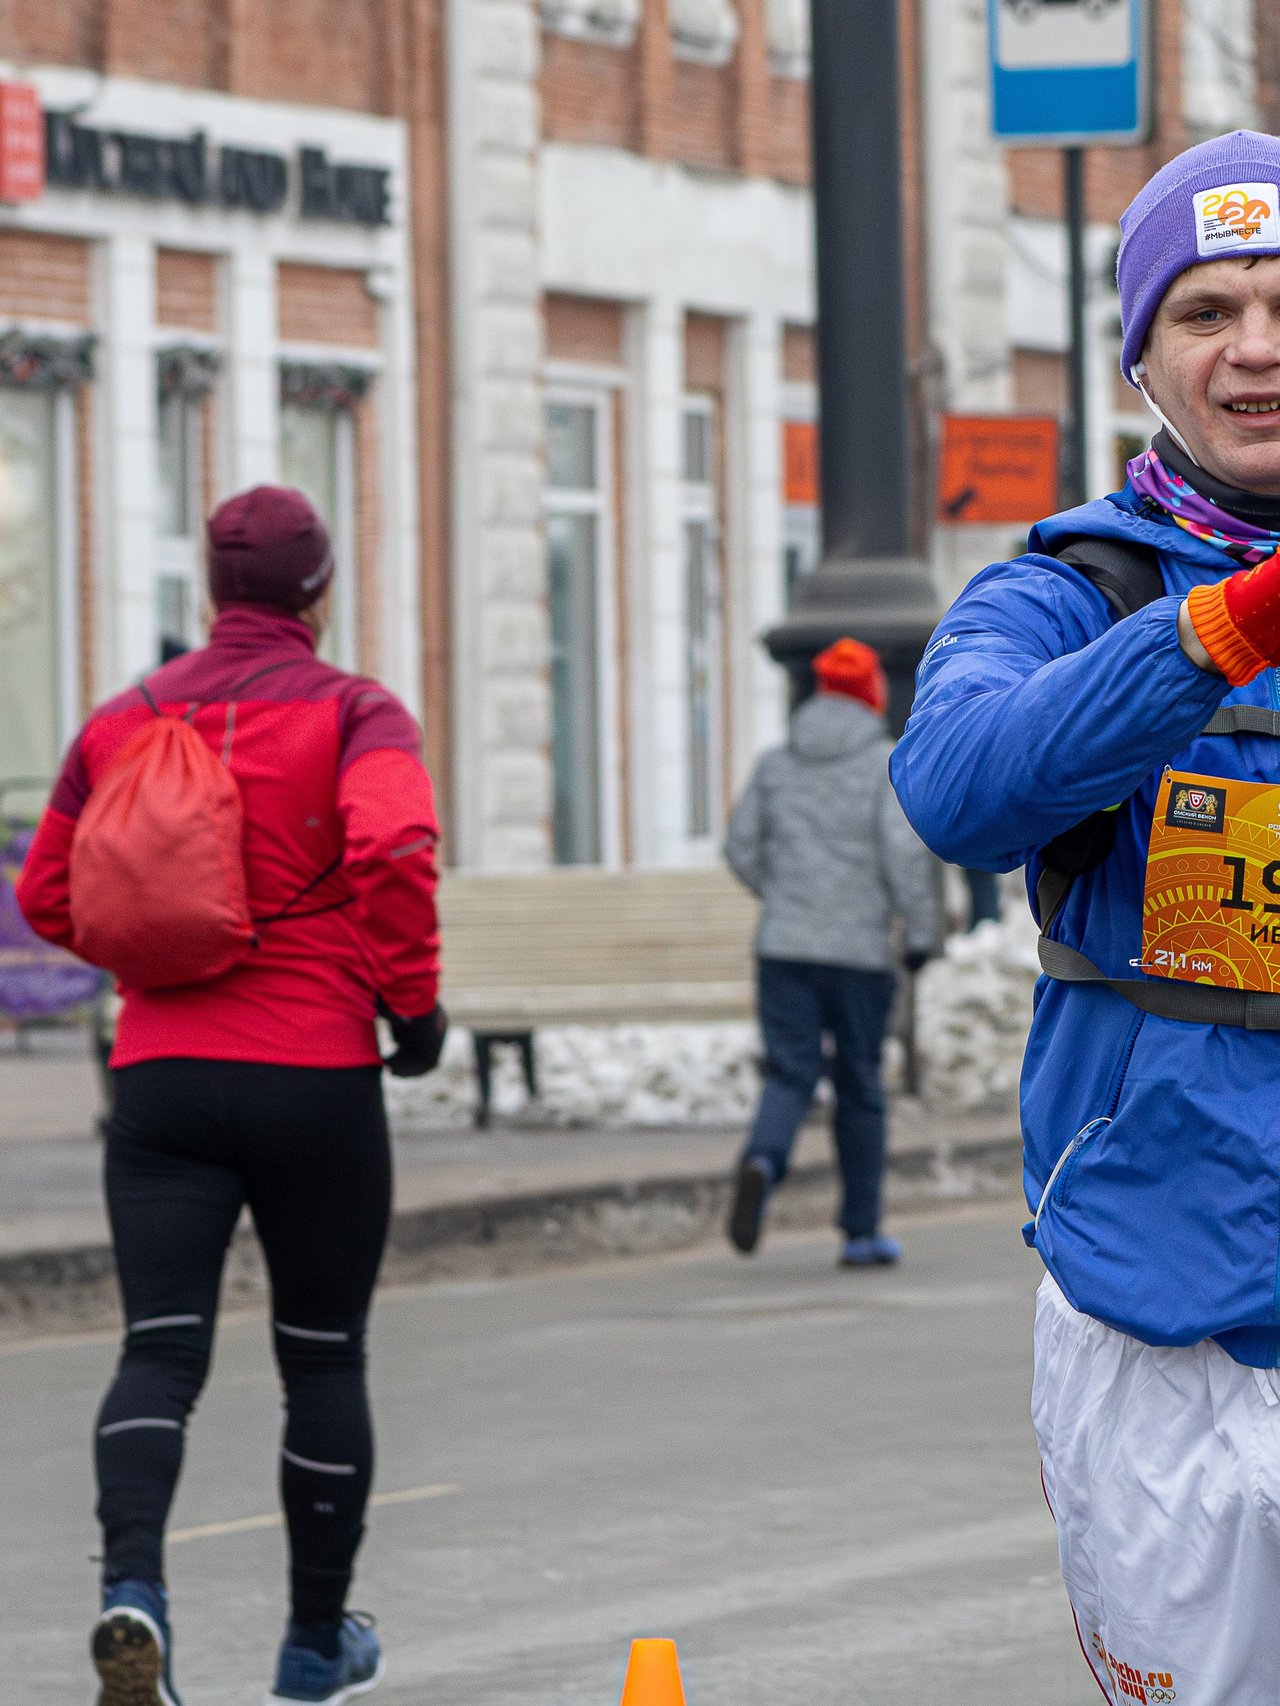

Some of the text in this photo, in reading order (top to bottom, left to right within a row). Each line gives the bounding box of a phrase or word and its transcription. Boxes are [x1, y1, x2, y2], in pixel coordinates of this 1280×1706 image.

[1204, 227, 1262, 241] #МЫВМЕСТЕ
[1173, 809, 1217, 821] ОМСКИЙ БЕКОН
[1154, 949, 1187, 969] 21,1
